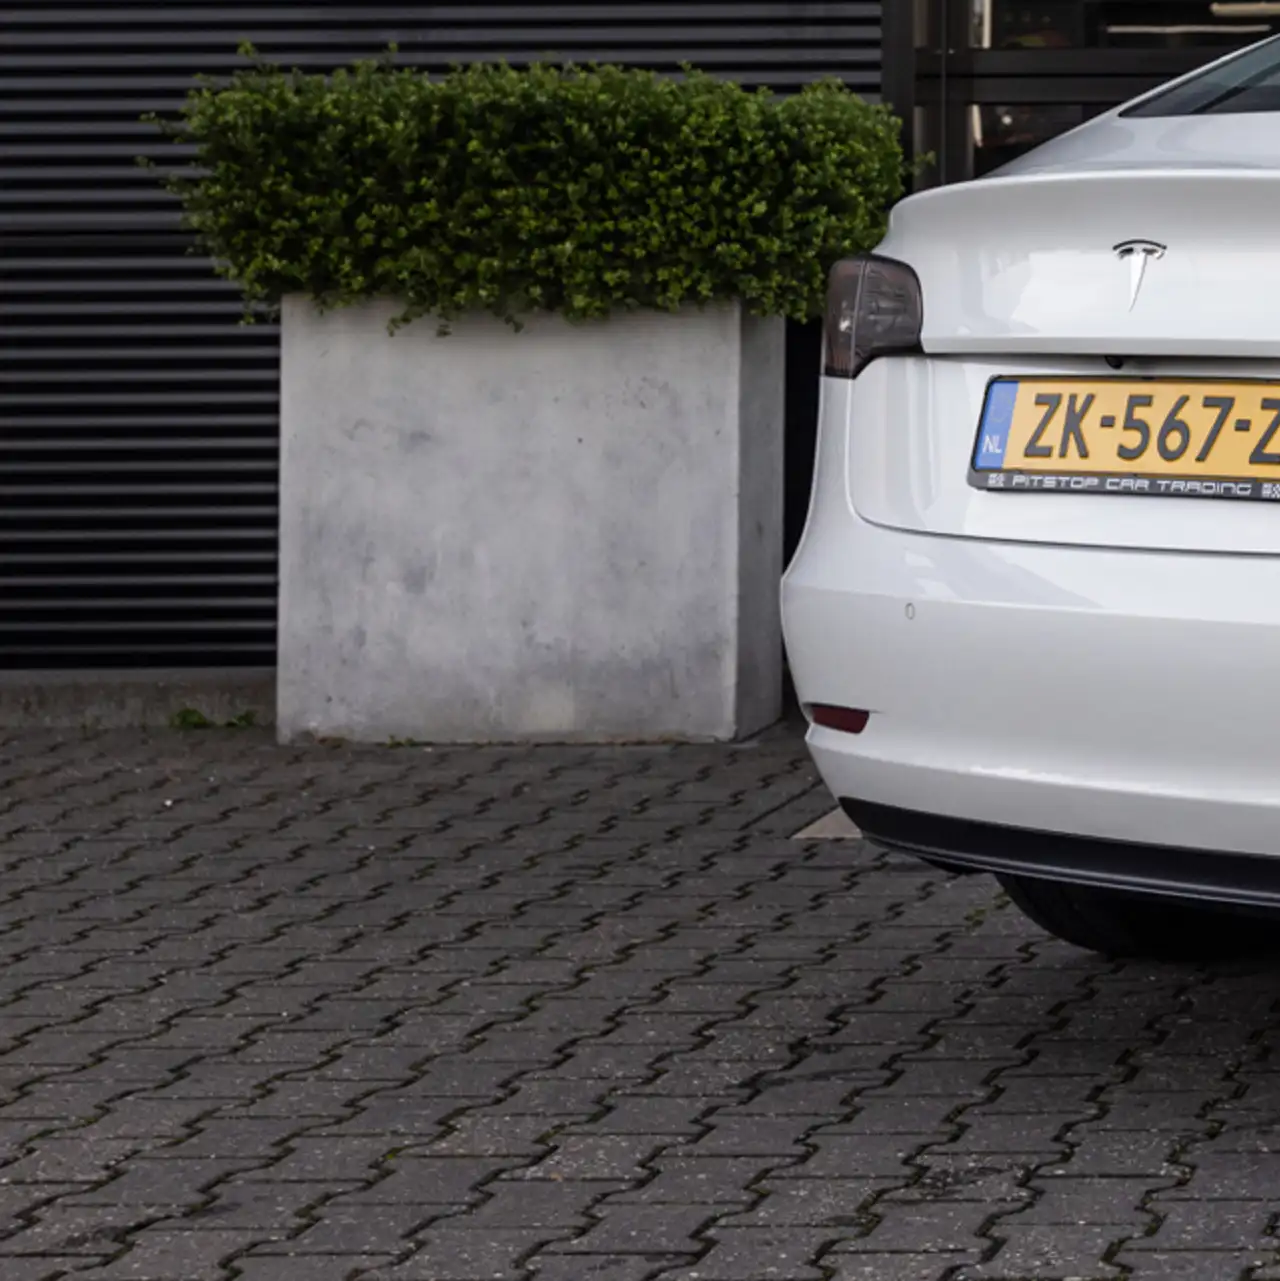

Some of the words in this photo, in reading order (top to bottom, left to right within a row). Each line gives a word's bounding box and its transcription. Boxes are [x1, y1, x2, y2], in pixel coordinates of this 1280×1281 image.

[982, 434, 1003, 454] NL
[1012, 474, 1099, 489] PITSTOP
[1105, 478, 1150, 491] CAR
[1156, 480, 1252, 496] TRADING
